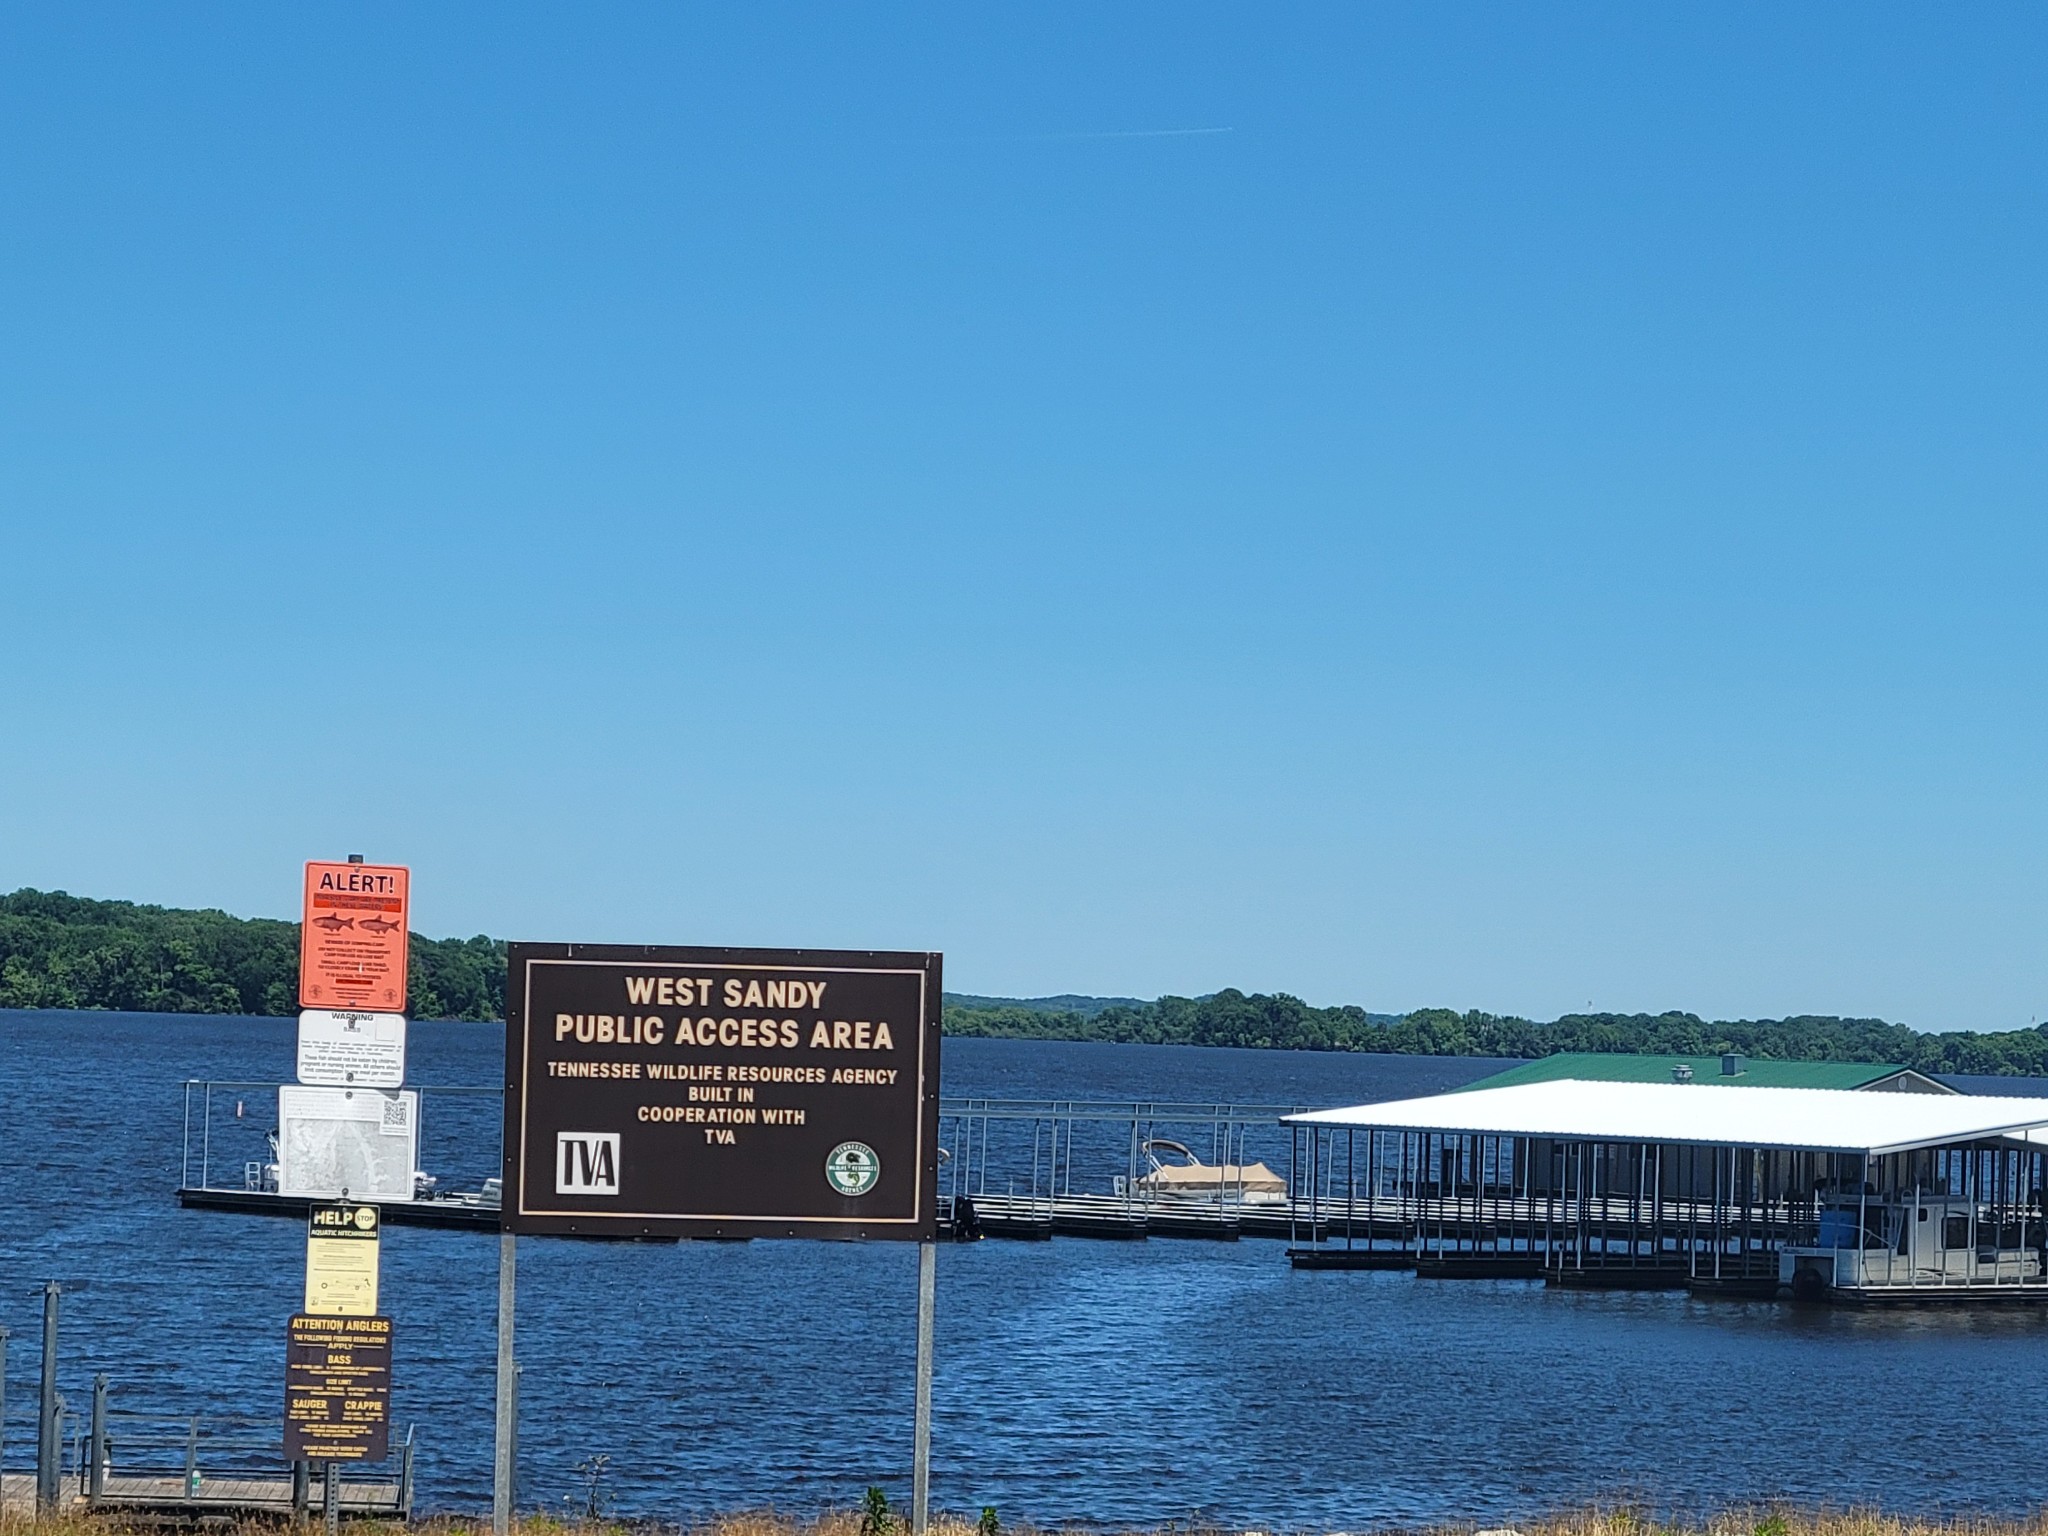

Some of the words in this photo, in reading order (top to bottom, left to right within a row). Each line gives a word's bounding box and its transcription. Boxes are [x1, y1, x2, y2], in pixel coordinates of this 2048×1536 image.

[319, 872, 394, 894] ALERT!
[626, 976, 713, 1007] WEST
[723, 979, 828, 1009] SANDY
[332, 1012, 374, 1021] WARNING
[555, 1014, 665, 1045] PUBLIC
[674, 1017, 799, 1049] ACCESS
[809, 1021, 893, 1050] AREA
[547, 1062, 641, 1079] TENNESSEE
[646, 1064, 723, 1082] WILDLIFE
[727, 1066, 826, 1083] RESOURCES
[832, 1068, 897, 1085] AGENCY
[688, 1087, 733, 1102] BUILT
[737, 1088, 754, 1103] IN
[637, 1106, 756, 1125] COOPERATION
[762, 1109, 805, 1125] WITH
[705, 1129, 736, 1145] TVA
[559, 1139, 616, 1187] TVA
[313, 1211, 353, 1225] HELP
[292, 1318, 343, 1330] ATTENTION
[346, 1320, 390, 1332] ANGLERS
[327, 1354, 352, 1364] BASS
[292, 1399, 328, 1409] SAUGER
[344, 1400, 383, 1411] CRAPPIE
